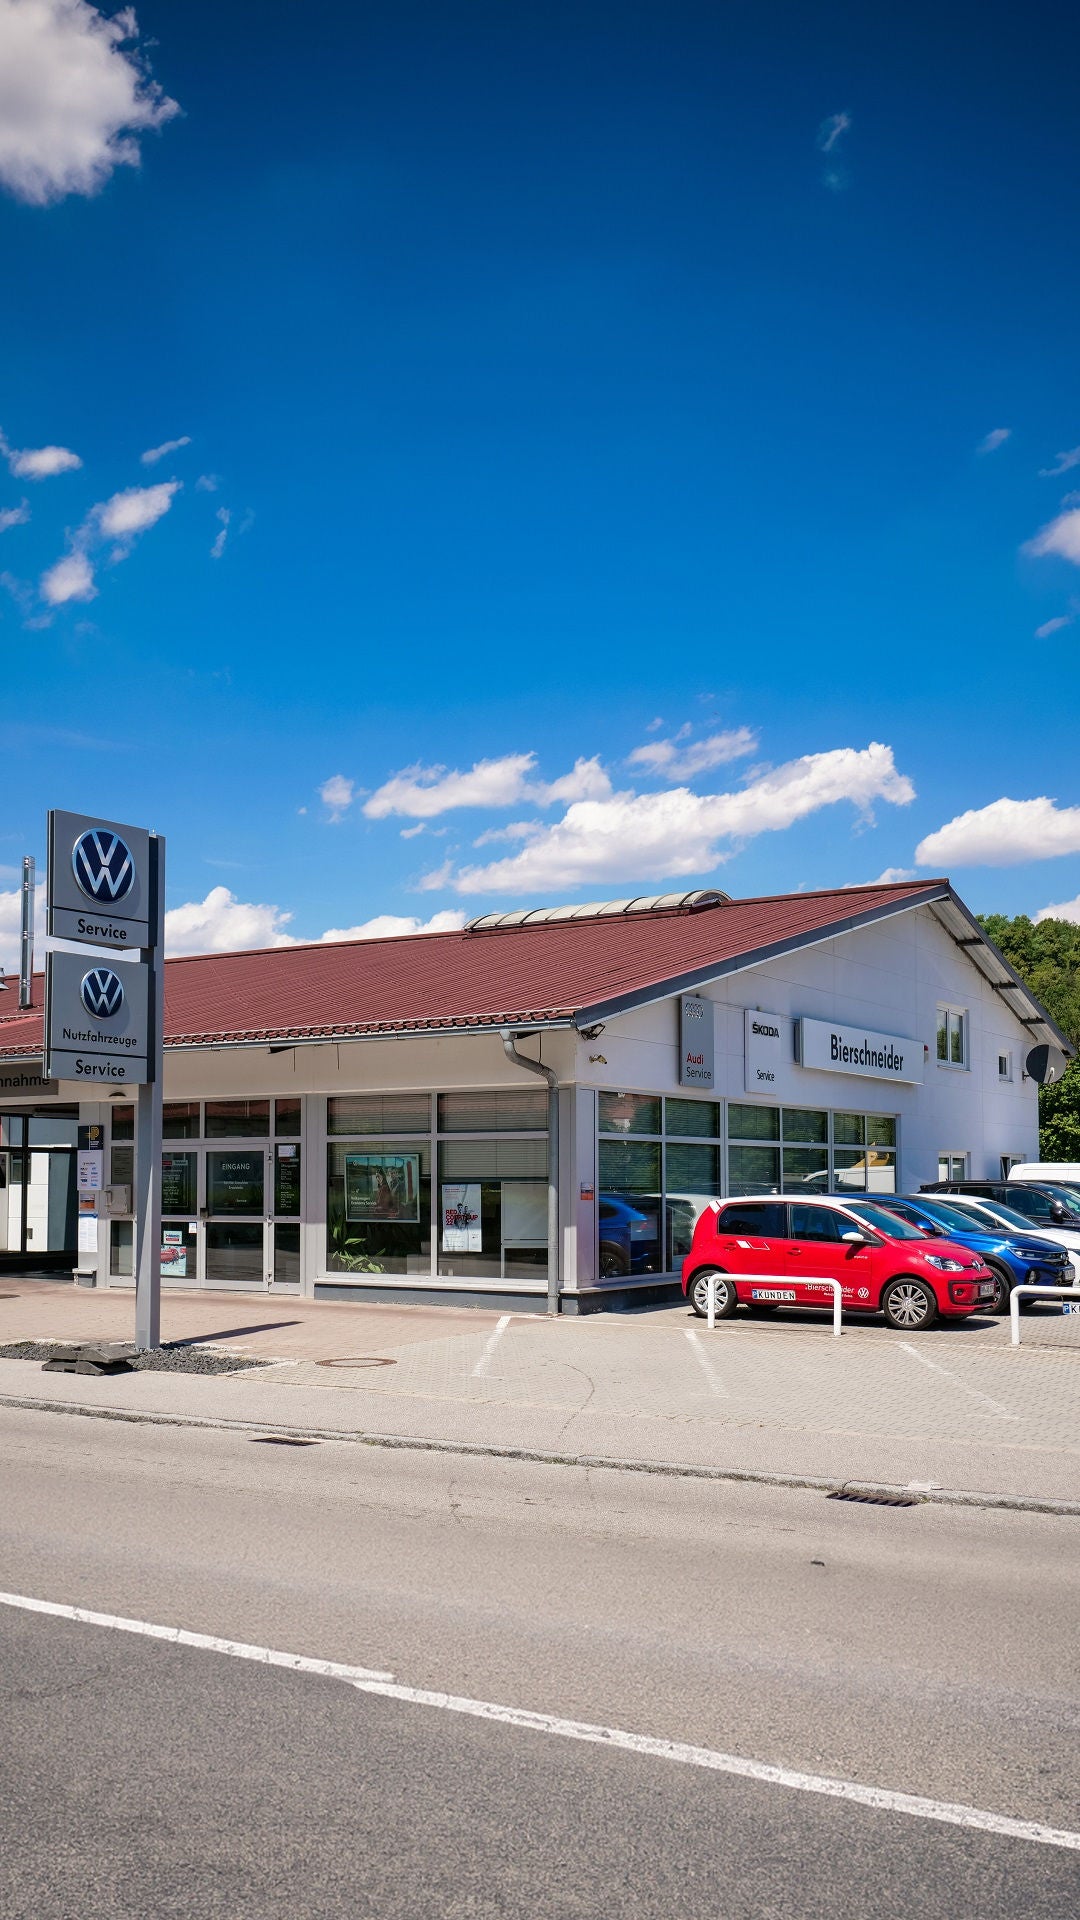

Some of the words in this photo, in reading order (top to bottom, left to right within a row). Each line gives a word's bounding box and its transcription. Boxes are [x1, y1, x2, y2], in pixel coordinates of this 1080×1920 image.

[77, 919, 127, 940] Service
[62, 1028, 137, 1048] Nutzfahrzeuge
[751, 1021, 780, 1039] ŠKODA
[686, 1052, 704, 1066] Audi
[830, 1033, 904, 1072] Bierschneider
[75, 1059, 126, 1077] Service
[686, 1066, 712, 1080] Service
[756, 1069, 775, 1082] Service
[758, 1290, 796, 1300] KUNDEN
